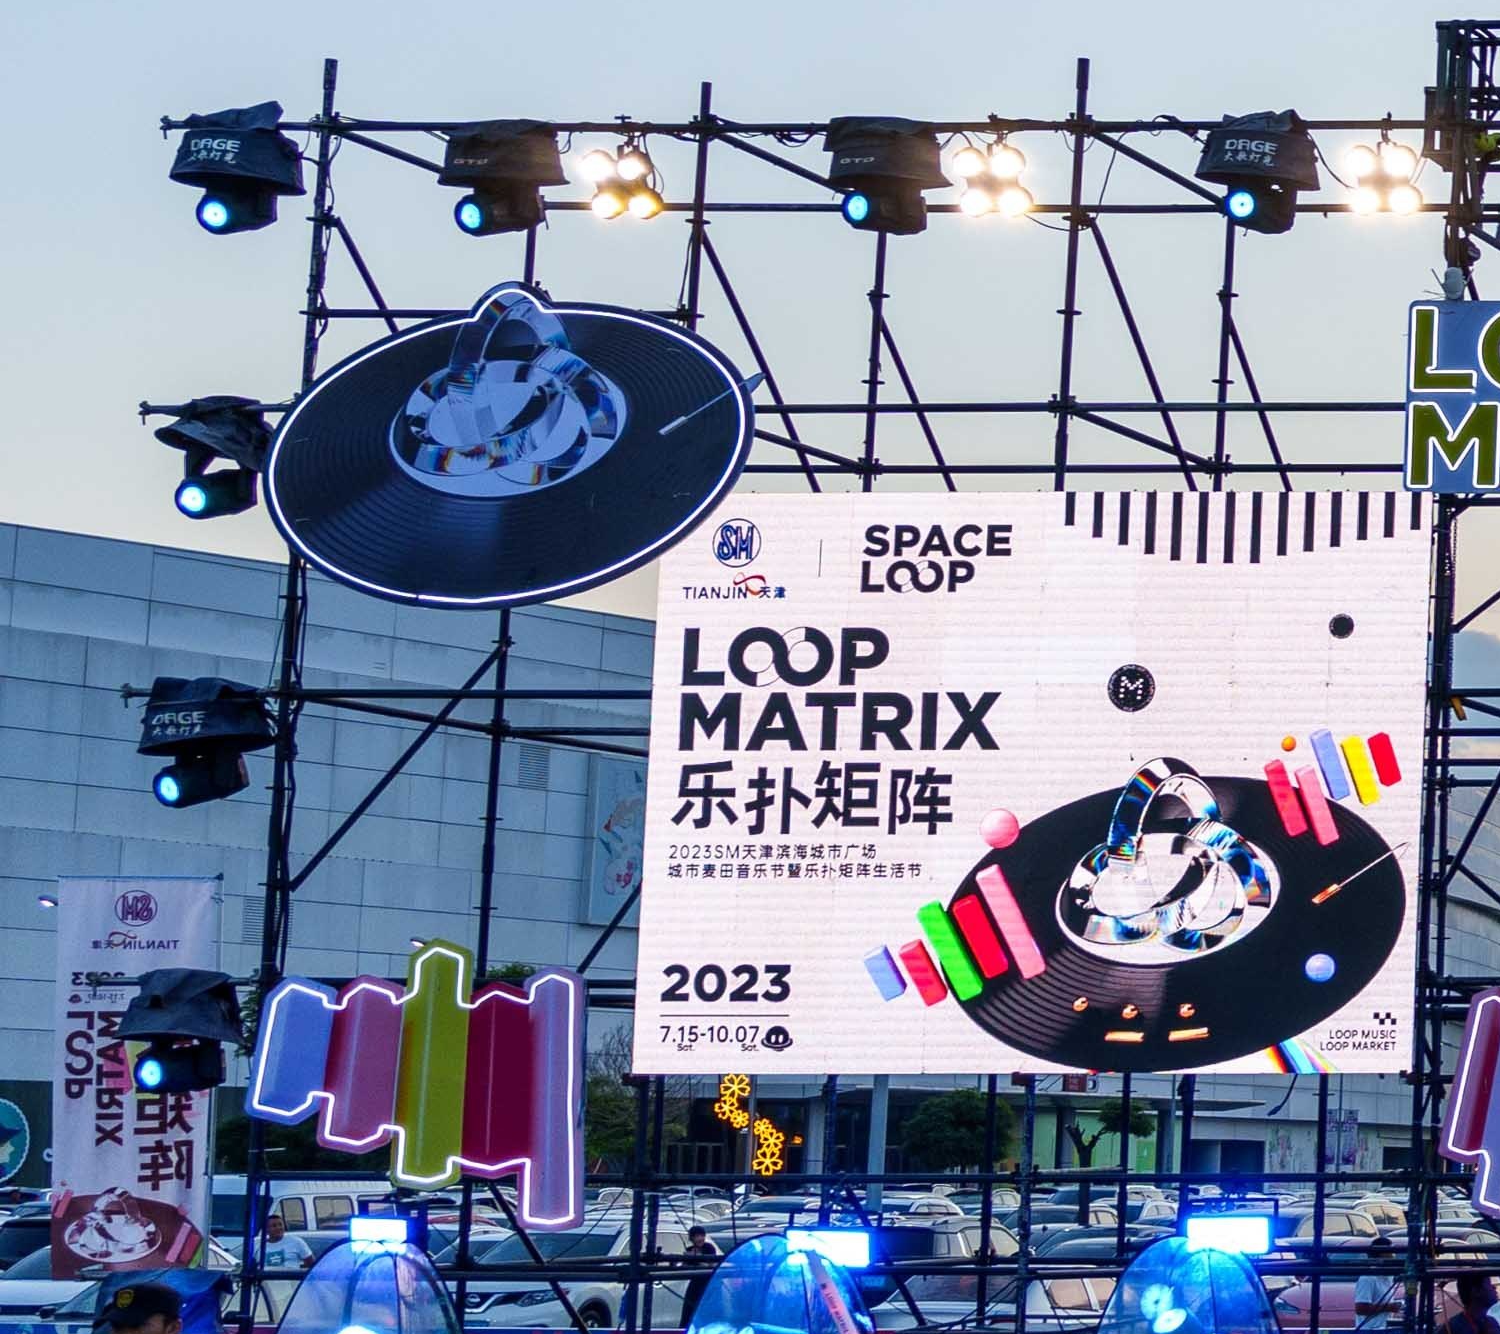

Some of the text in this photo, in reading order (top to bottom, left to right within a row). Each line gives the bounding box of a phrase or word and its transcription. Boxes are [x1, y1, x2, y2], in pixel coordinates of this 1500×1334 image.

[191, 138, 241, 153] DAGE
[1224, 138, 1279, 155] DAGE
[716, 524, 755, 562] SM
[863, 524, 1013, 557] SPACE
[861, 560, 975, 594] LOOP
[683, 585, 787, 600] TIANJIN 天津
[682, 627, 890, 688] LOOP
[151, 710, 206, 725] DAGE
[678, 691, 1002, 752] MATRIX
[670, 759, 954, 836] 乐扑矩阵
[669, 843, 877, 860] 2023SM天津滨海城市广场
[667, 862, 922, 879] 城市麦田音乐节暨乐扑矩阵生活节
[660, 963, 792, 1003] 2023
[660, 1025, 760, 1044] 7.15-10.07
[1329, 1029, 1397, 1040] LOOP MUSIC
[1320, 1040, 1397, 1051] LOOP MARKET
